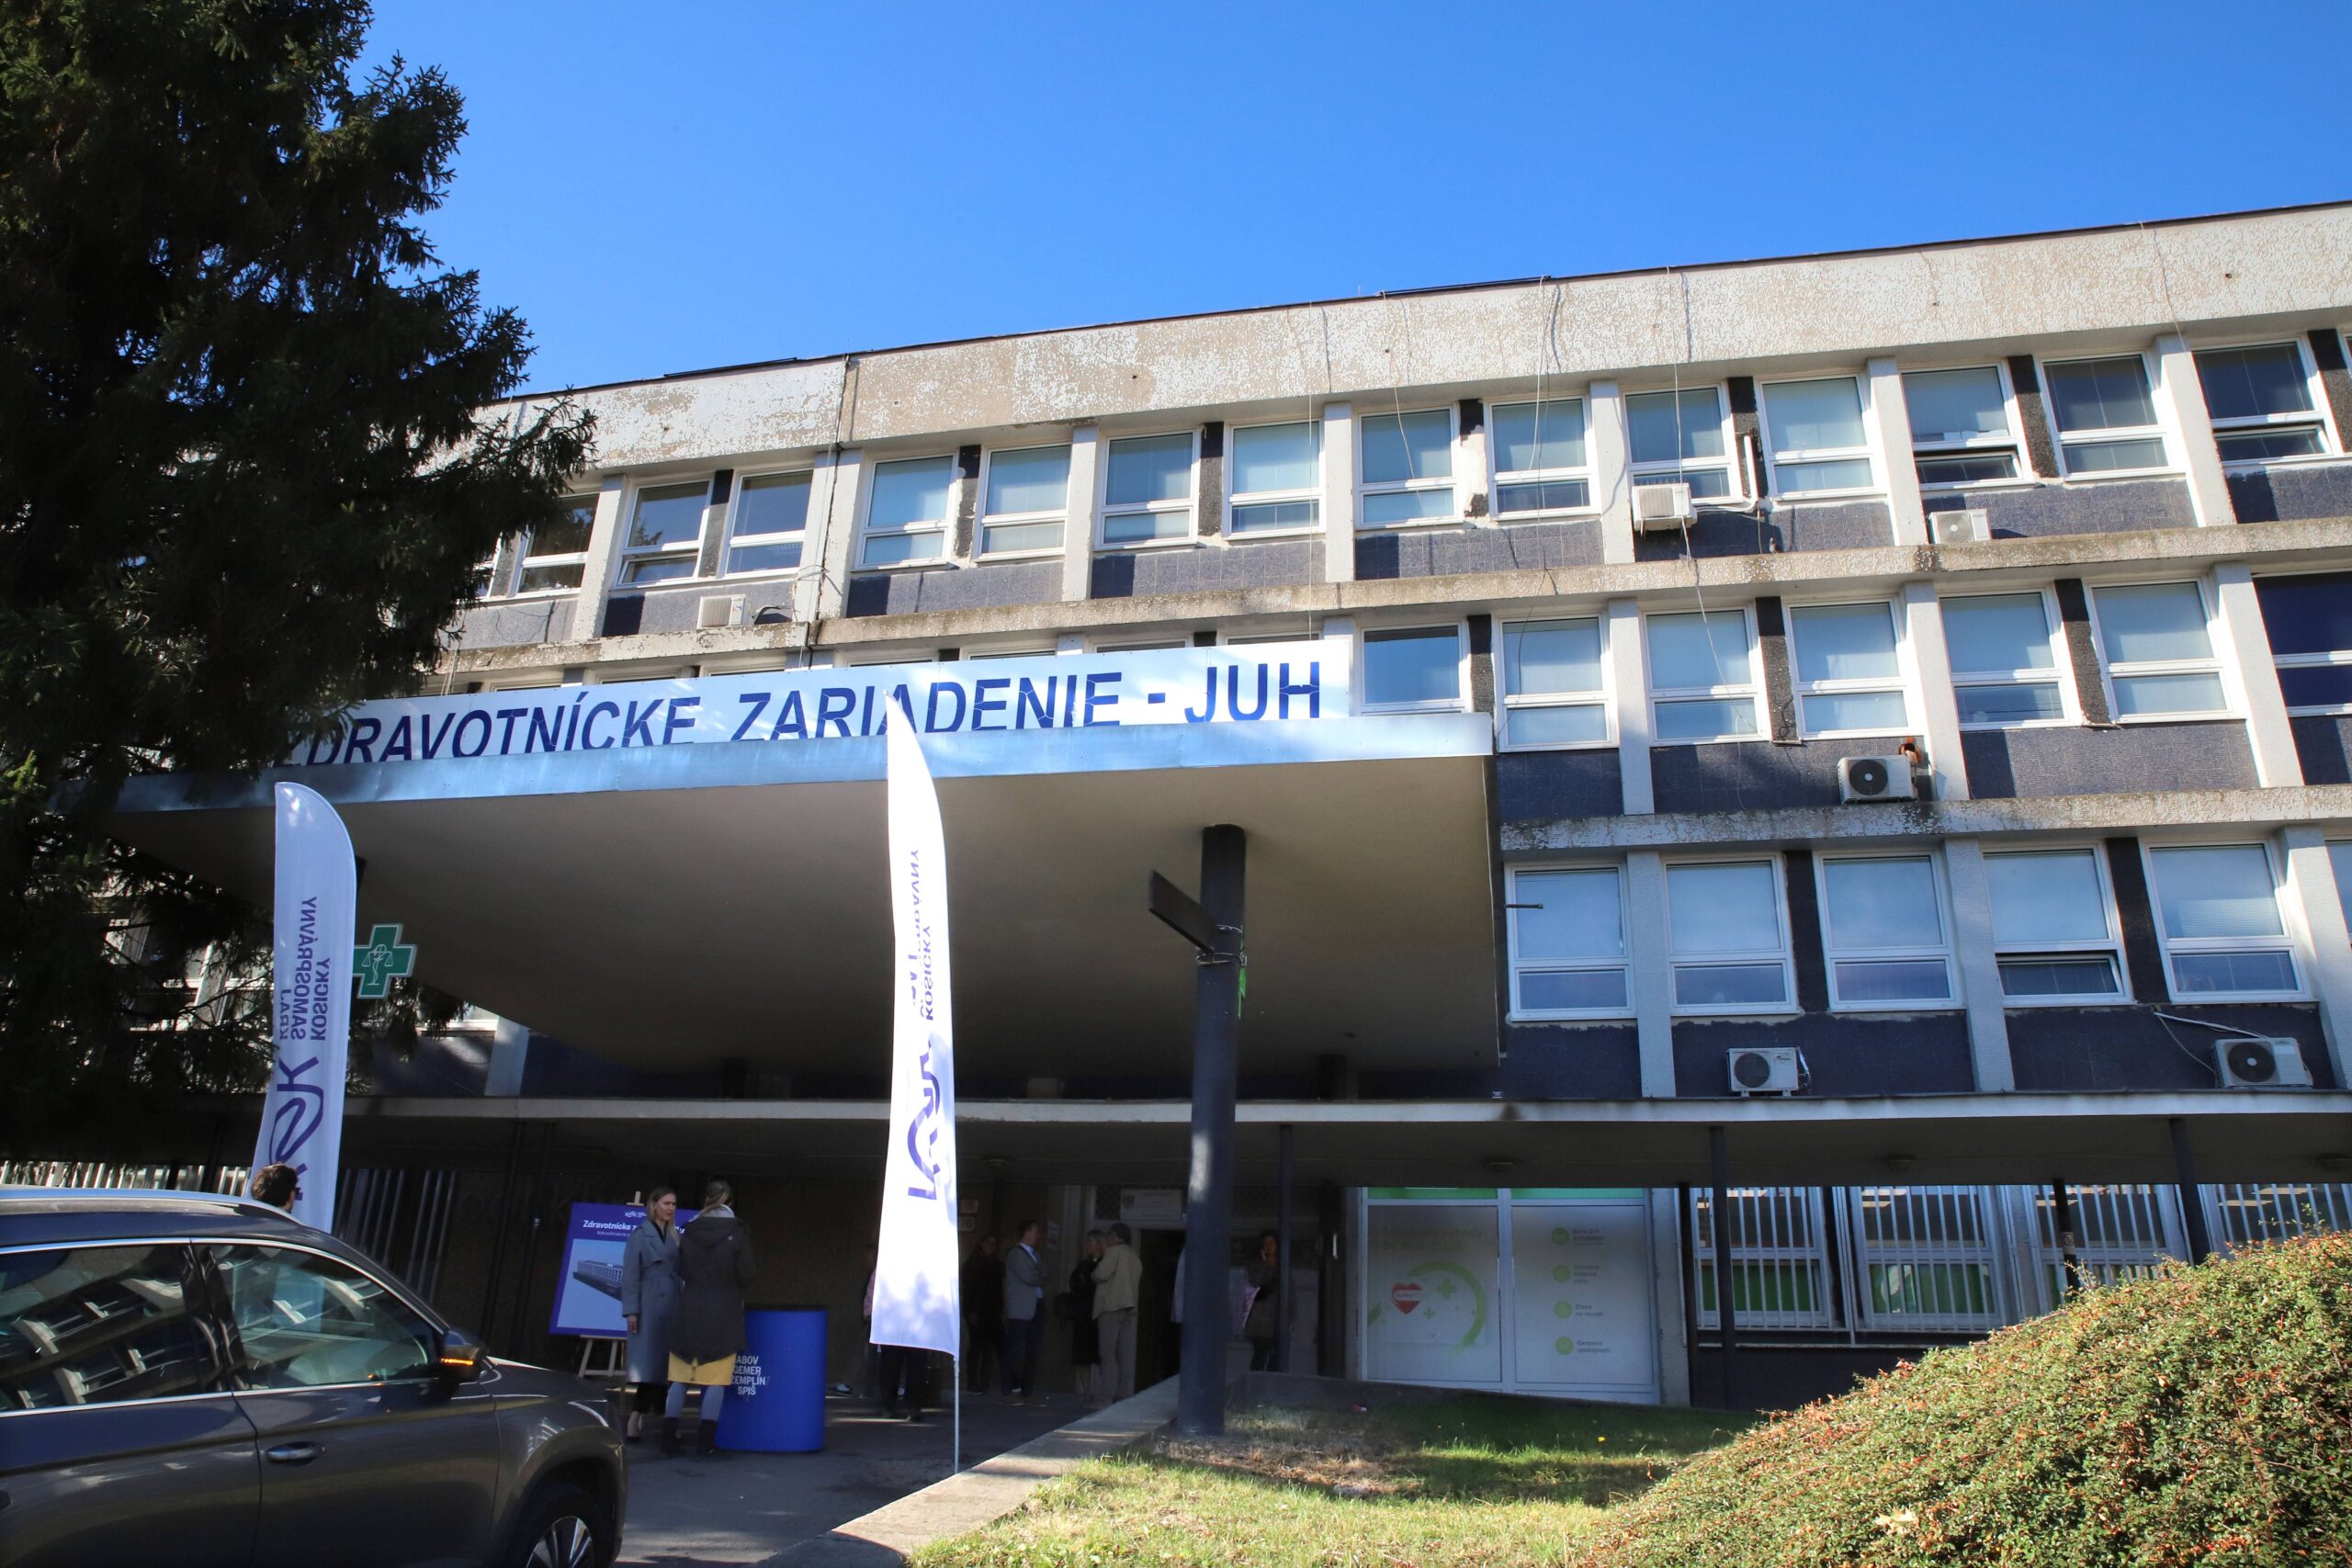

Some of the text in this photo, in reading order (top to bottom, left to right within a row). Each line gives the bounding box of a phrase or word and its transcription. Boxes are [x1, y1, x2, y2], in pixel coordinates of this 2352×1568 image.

[729, 671, 1124, 742] ZARIADENIE
[1148, 693, 1165, 704] -
[1183, 661, 1320, 723] JUH
[736, 1355, 759, 1365] ABOV
